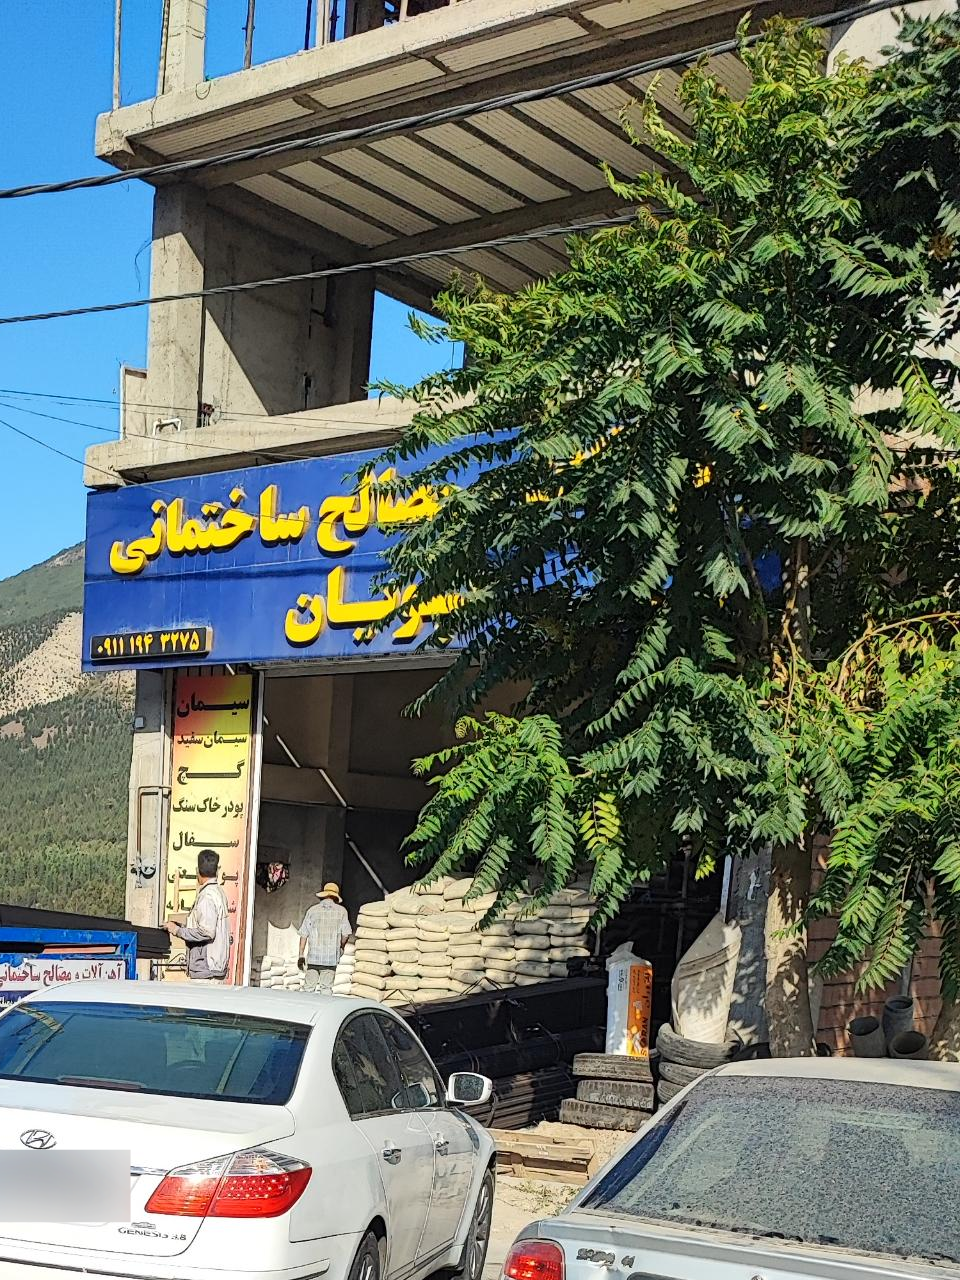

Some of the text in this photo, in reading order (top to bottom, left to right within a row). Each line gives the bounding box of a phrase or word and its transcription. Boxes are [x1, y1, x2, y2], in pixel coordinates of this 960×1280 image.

[109, 483, 310, 576] ساختمانی
[97, 631, 200, 656] ۰۹۱۱ ۱۹۴ ۳۲۷۵
[176, 692, 250, 718] سیمان
[177, 731, 247, 749] سیمان سفید
[177, 758, 246, 786] گچ
[196, 797, 222, 813] خاک
[221, 801, 244, 819] پودر
[172, 830, 240, 851] سفال
[43, 964, 73, 987] مصالح
[118, 1226, 169, 1239] GENESIS
